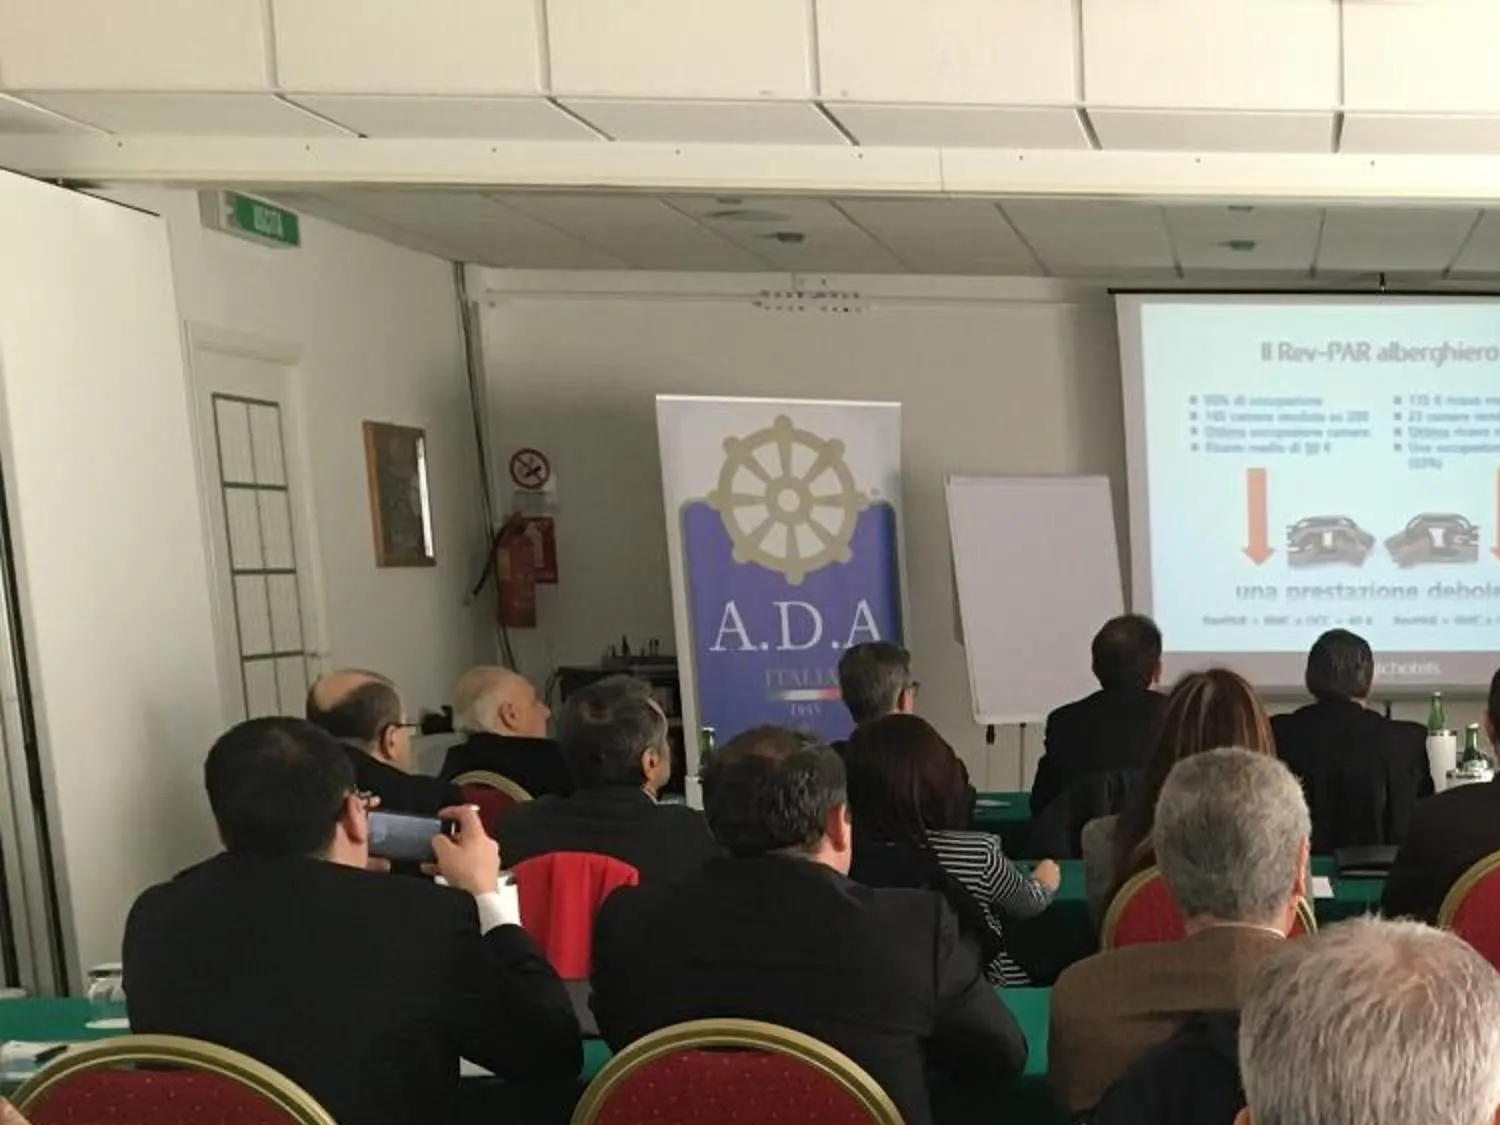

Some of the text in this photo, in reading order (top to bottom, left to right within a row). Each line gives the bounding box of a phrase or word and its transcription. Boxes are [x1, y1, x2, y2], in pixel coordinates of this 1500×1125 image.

[1261, 341, 1500, 367] Il Rev-PAR alberghiero
[1236, 583, 1278, 602] una
[1286, 579, 1420, 602] prestazione
